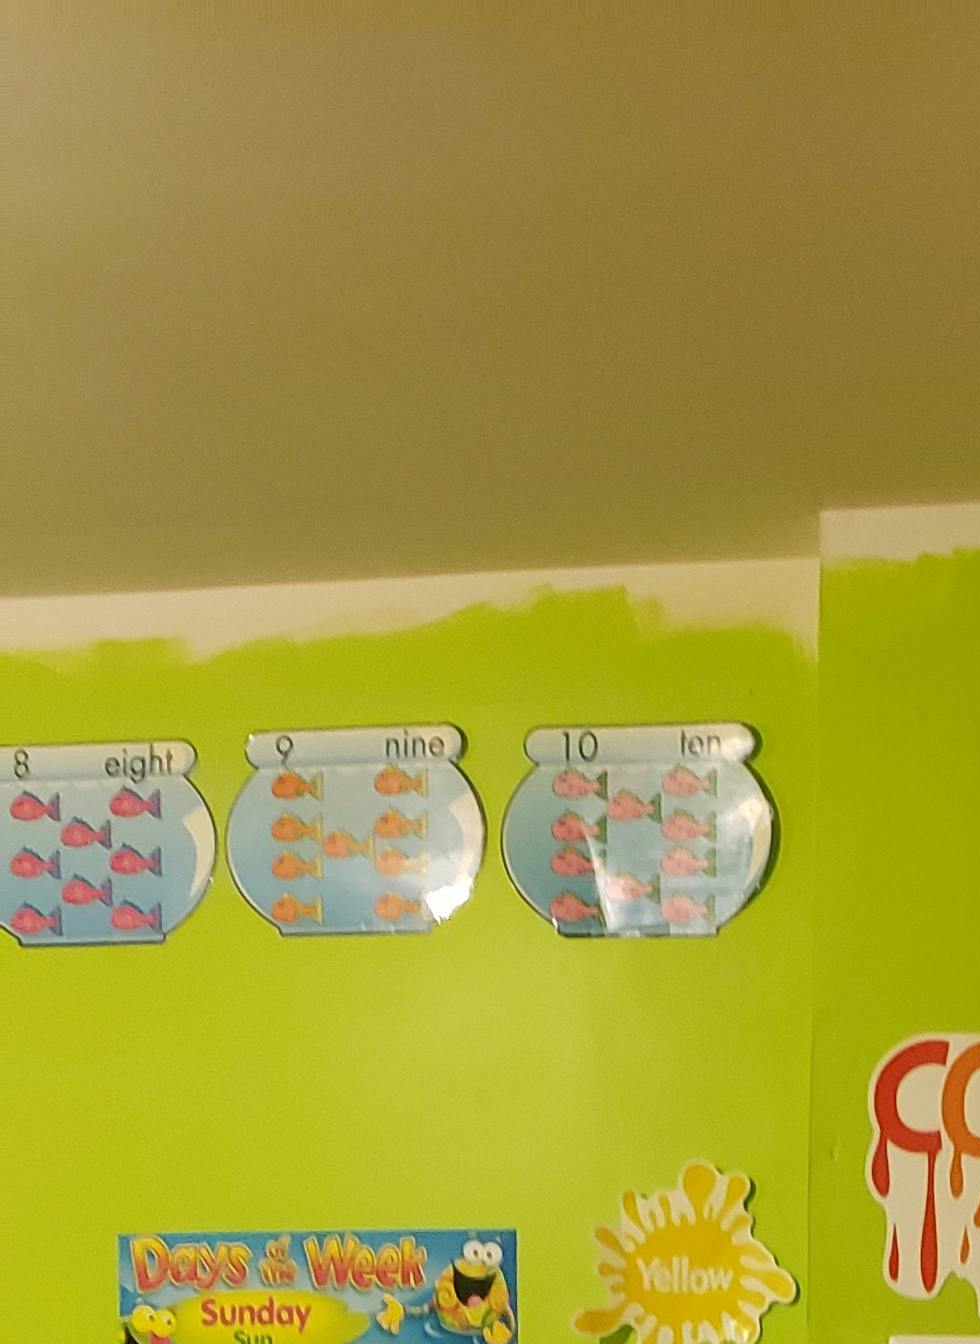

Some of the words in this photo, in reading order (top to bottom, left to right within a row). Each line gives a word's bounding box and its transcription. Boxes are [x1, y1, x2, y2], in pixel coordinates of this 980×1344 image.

[276, 734, 295, 765] 9
[386, 730, 446, 759] nine
[561, 731, 599, 763] 10
[14, 750, 30, 779] 8
[104, 748, 174, 784] eight
[129, 1234, 252, 1294] Days
[302, 1234, 428, 1291] Week
[636, 1256, 734, 1295] Yellow
[201, 1296, 311, 1333] Sunday
